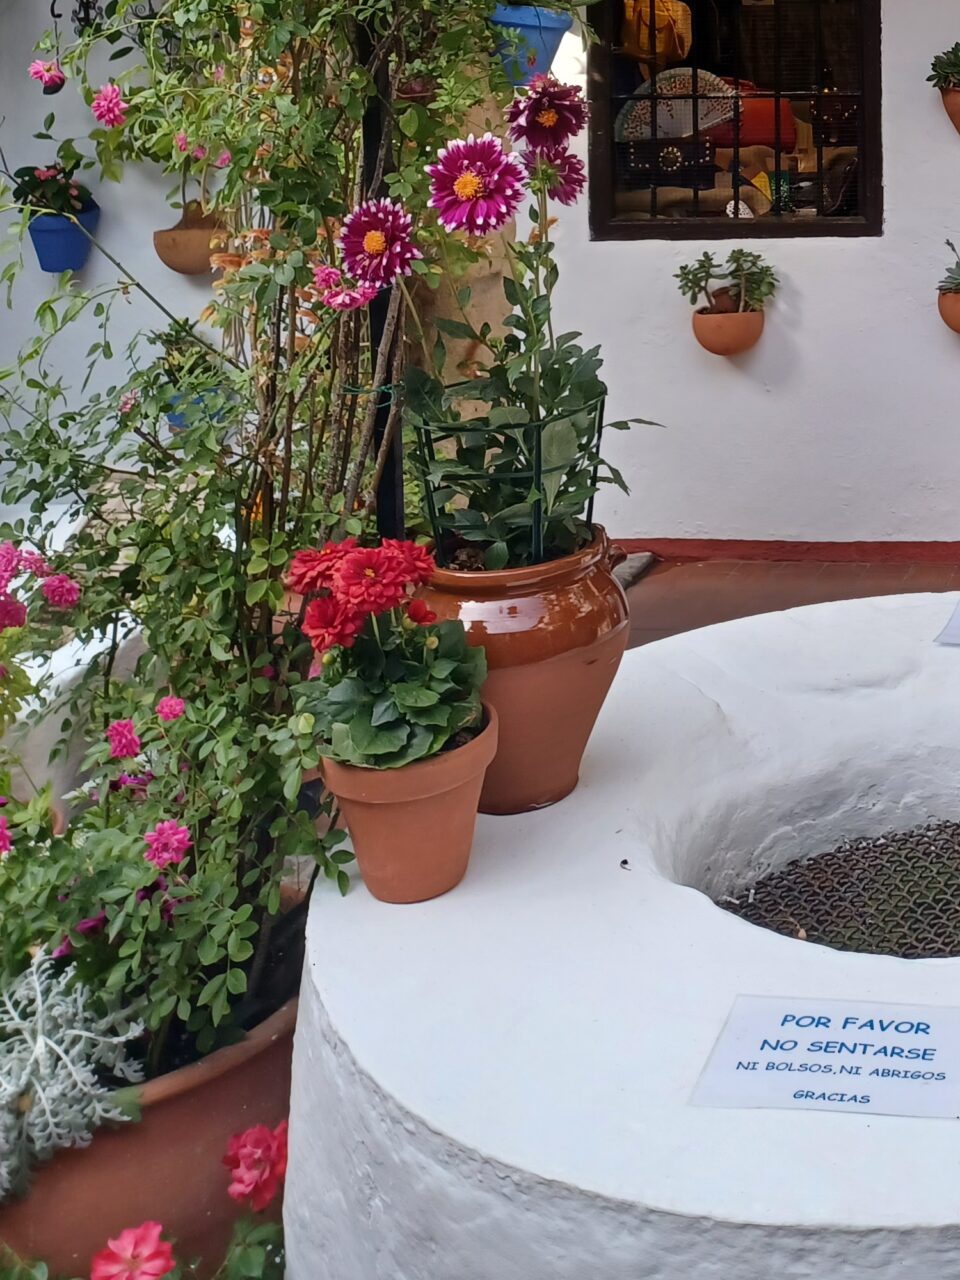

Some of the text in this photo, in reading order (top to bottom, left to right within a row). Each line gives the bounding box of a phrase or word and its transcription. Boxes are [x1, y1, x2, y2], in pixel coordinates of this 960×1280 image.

[780, 1014, 931, 1035] POR FAVOR
[759, 1038, 937, 1061] NO SENTARSE
[735, 1061, 760, 1071] NI
[868, 1068, 947, 1081] ABRIGOS
[792, 1089, 871, 1104] GRACIAS
